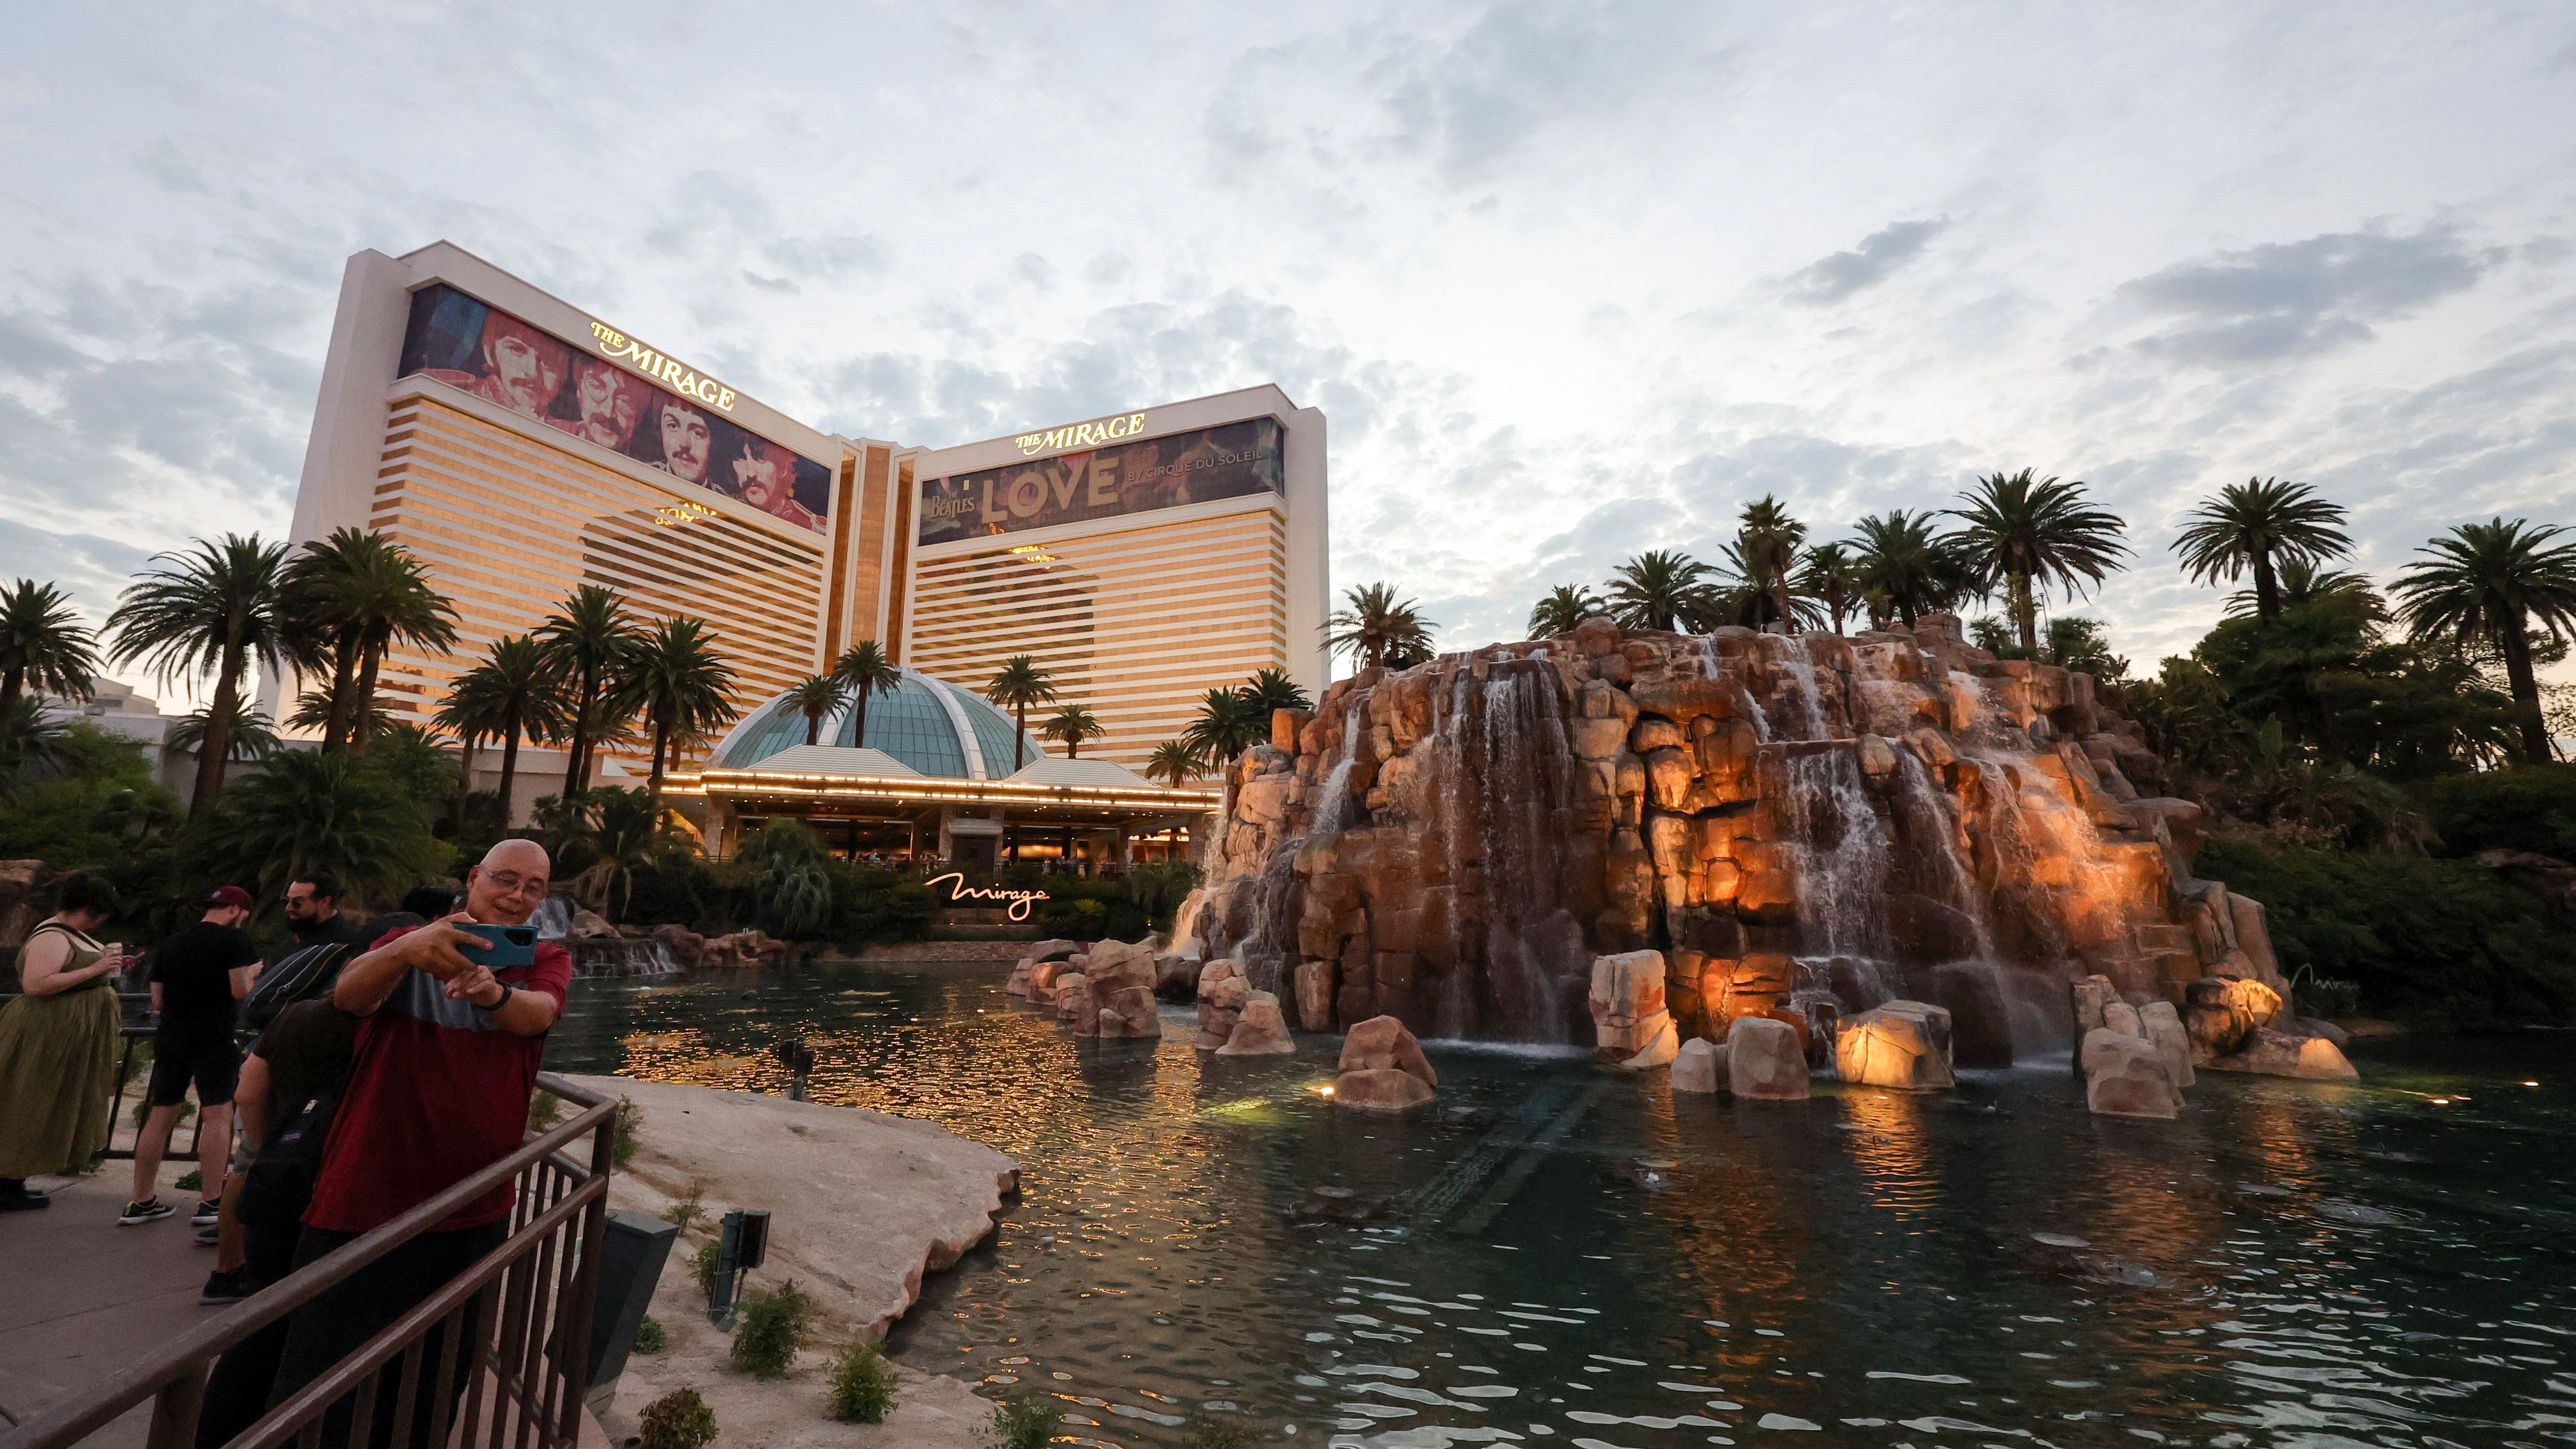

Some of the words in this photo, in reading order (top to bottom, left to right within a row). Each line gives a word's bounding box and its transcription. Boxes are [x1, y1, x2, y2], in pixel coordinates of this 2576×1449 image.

[590, 321, 625, 348] THE
[599, 340, 736, 412] MIRAGE
[1015, 432, 1042, 449] THE
[1023, 412, 1146, 456] MIRAGE
[1127, 471, 1144, 482] BY
[1146, 462, 1192, 477] CIRQUE
[1196, 457, 1214, 469] DU
[1218, 449, 1264, 465] SOLEIL
[932, 495, 975, 518] BEATLES
[981, 455, 1120, 525] LOVE
